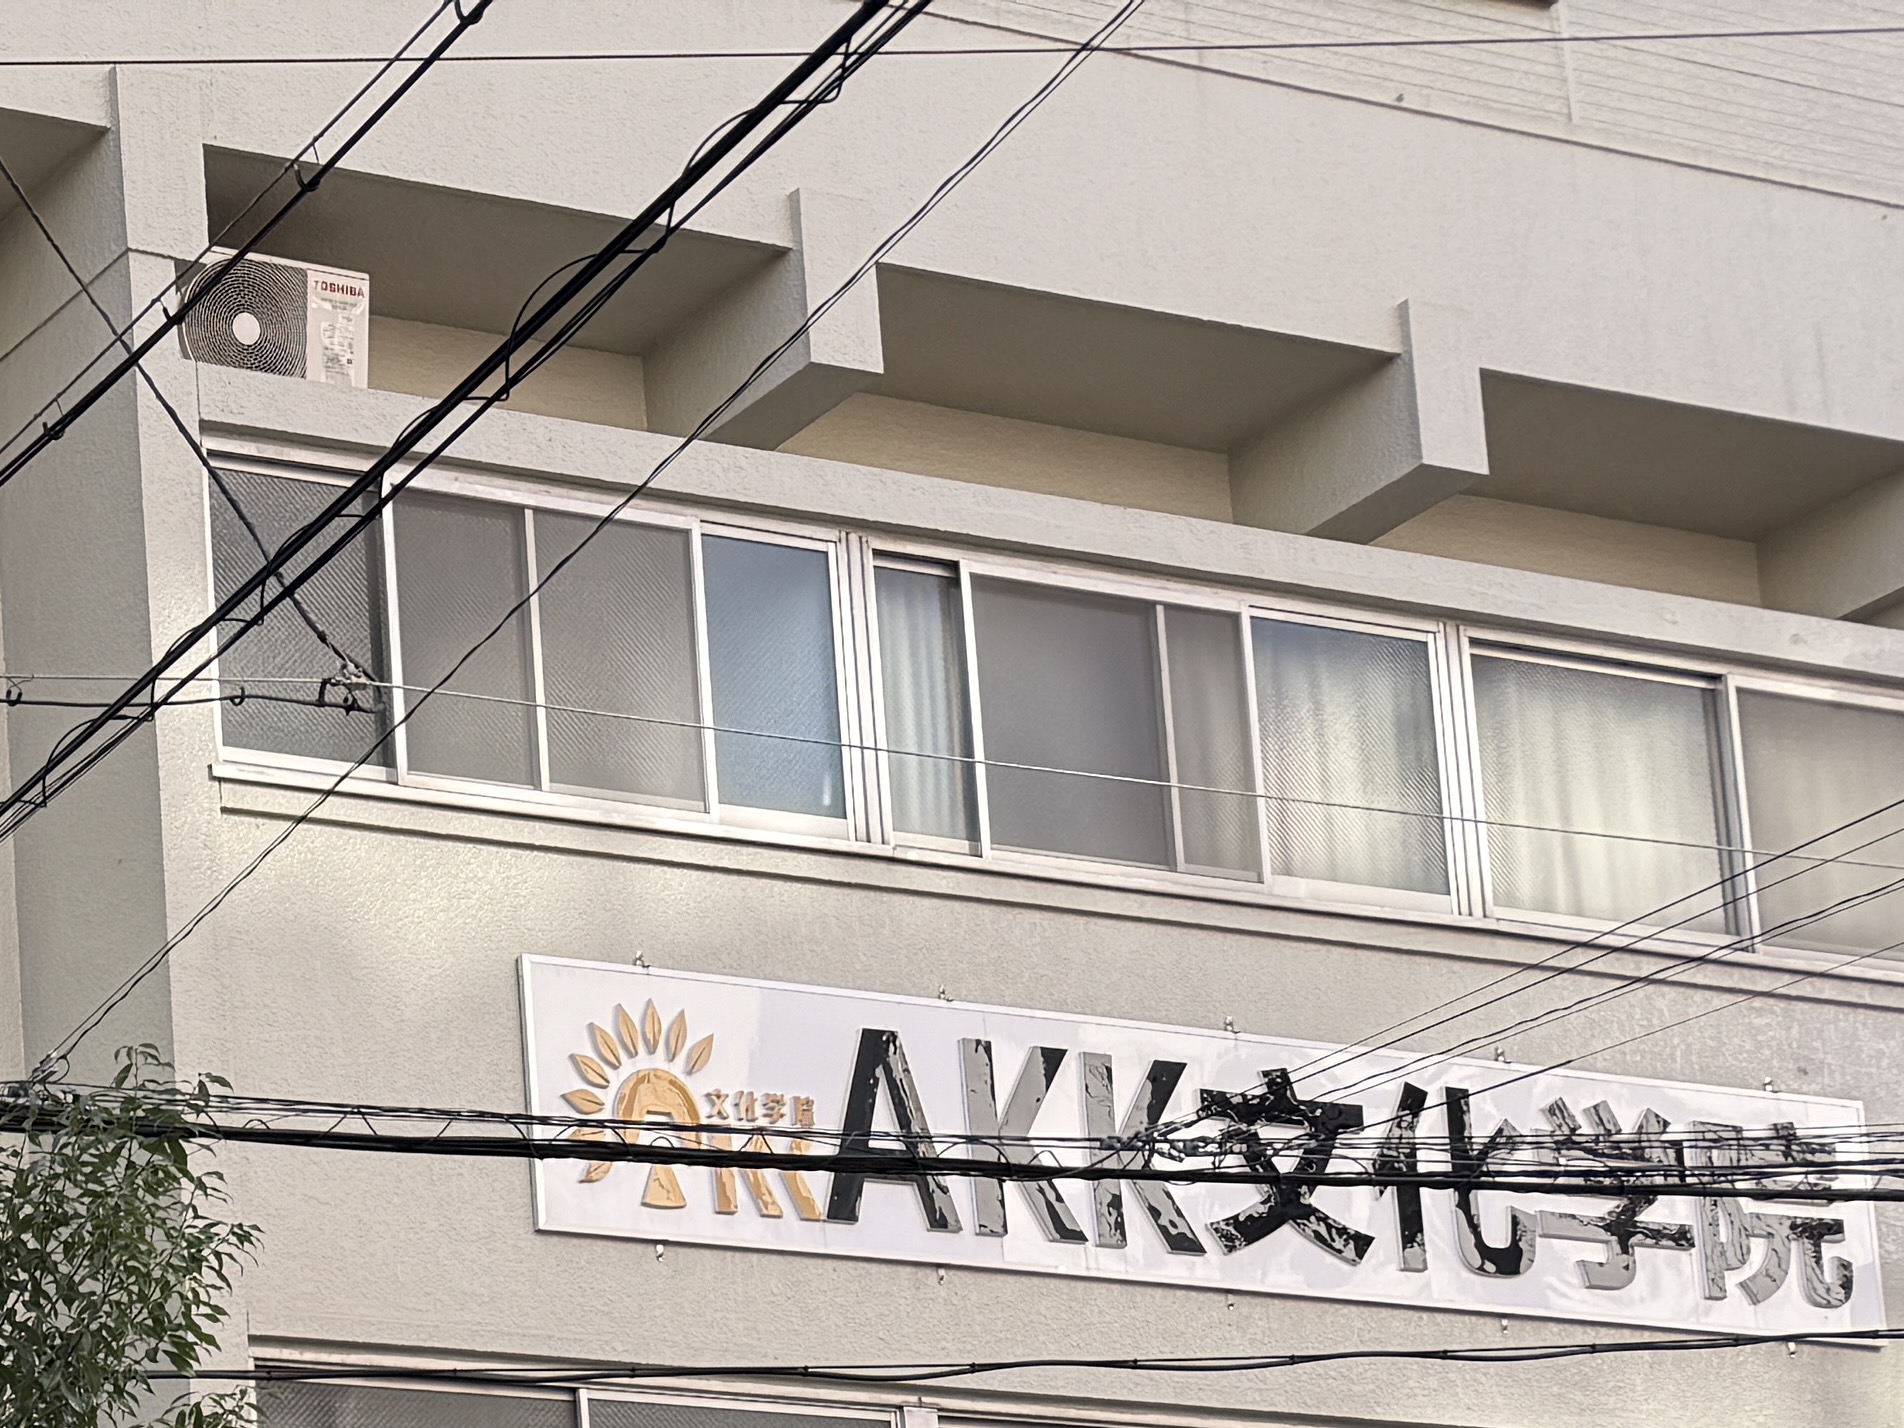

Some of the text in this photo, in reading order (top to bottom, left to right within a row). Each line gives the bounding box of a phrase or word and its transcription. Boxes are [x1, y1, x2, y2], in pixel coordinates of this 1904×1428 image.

[313, 280, 365, 298] TOSHIBA
[705, 1088, 818, 1128] 文化学院
[825, 1026, 1856, 1310] AKK文化学院
